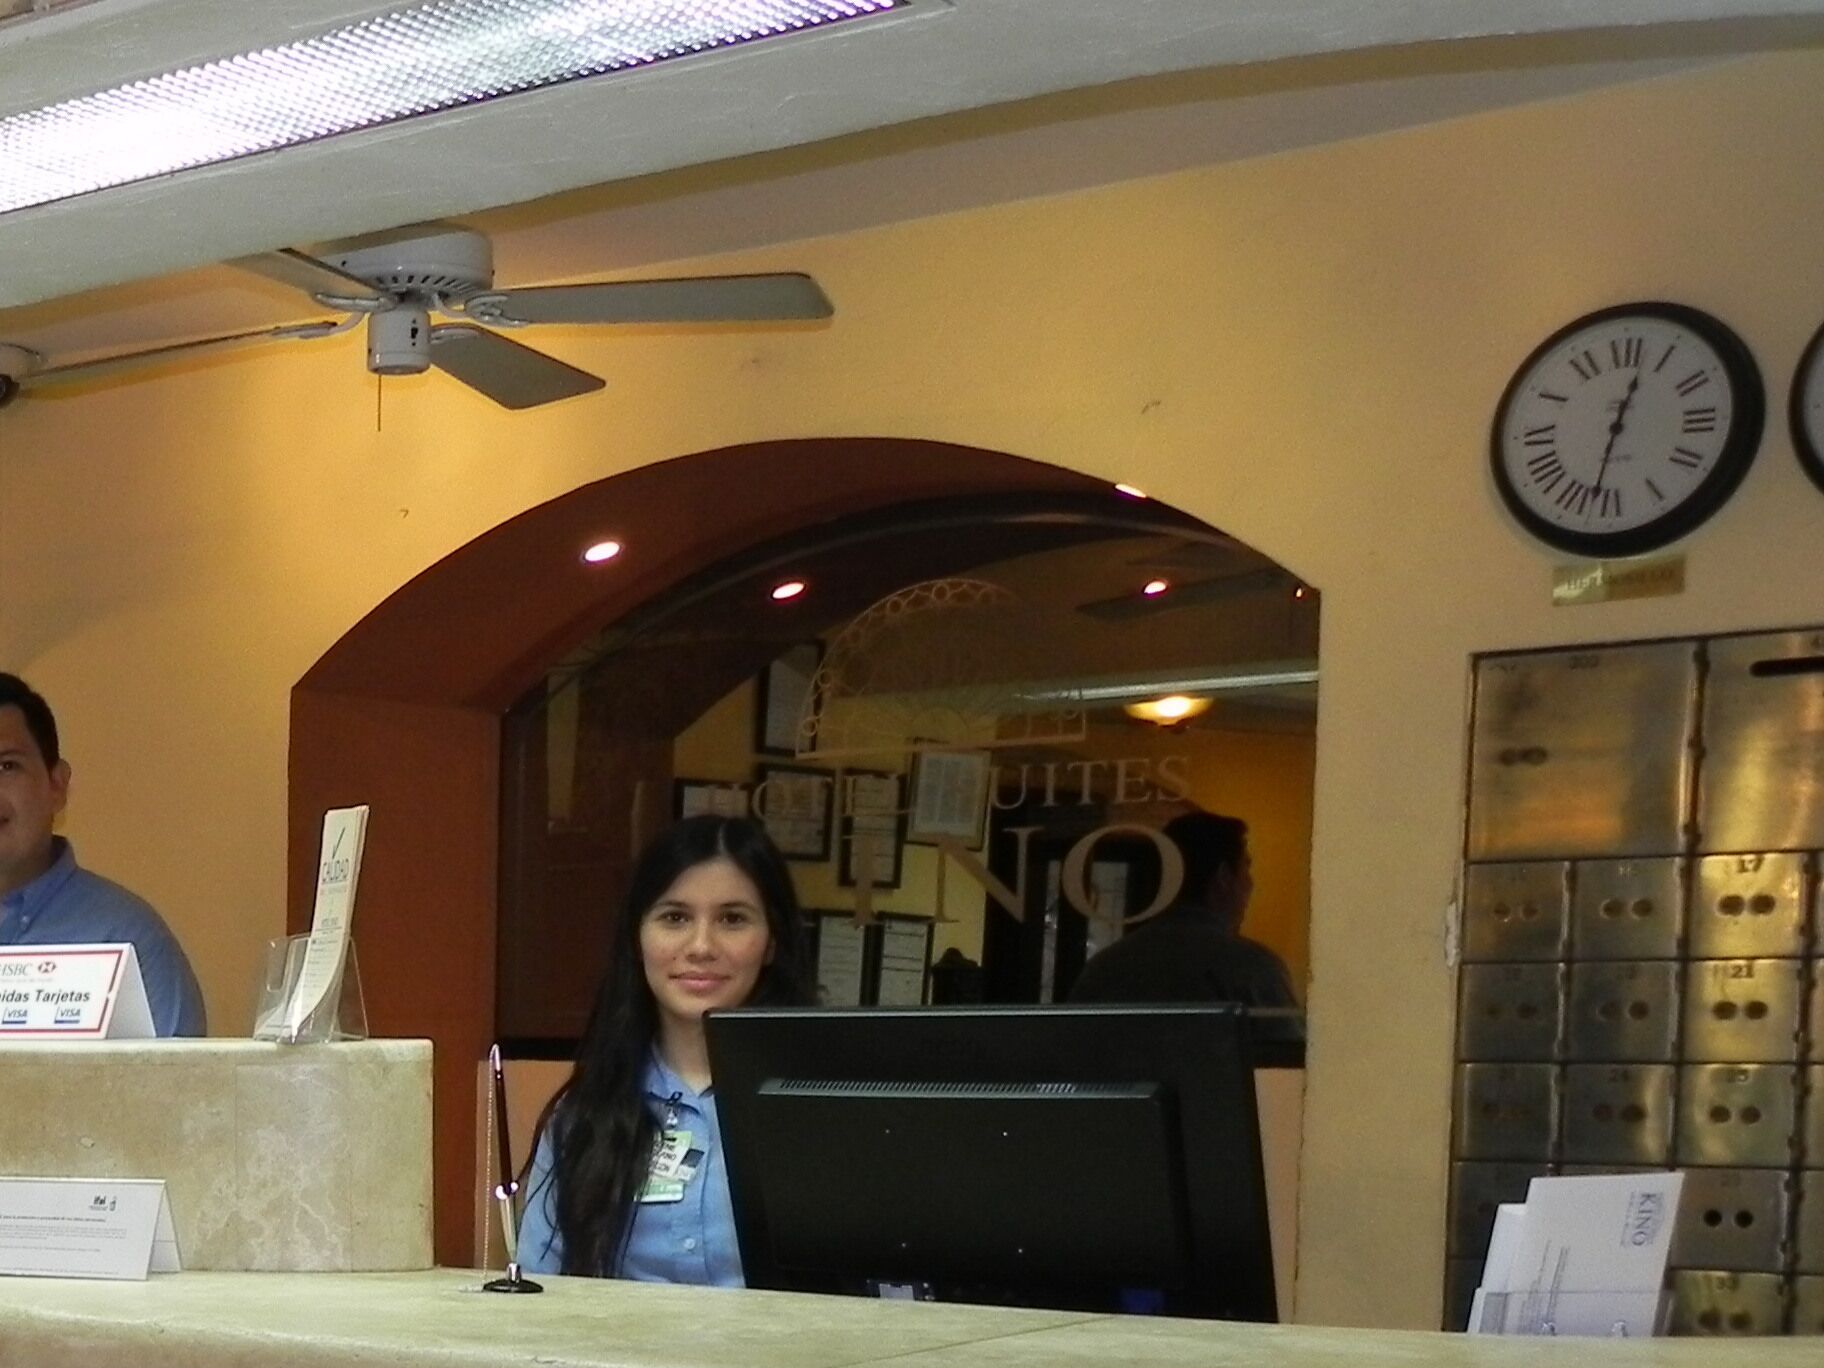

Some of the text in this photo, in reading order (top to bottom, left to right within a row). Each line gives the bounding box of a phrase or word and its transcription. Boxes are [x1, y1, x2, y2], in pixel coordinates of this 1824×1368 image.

[1737, 857, 1766, 874] 17
[1731, 964, 1756, 980] 21
[34, 988, 91, 1005] Tarjetas
[7, 1008, 81, 1018] VISA VISA
[1631, 1193, 1657, 1247] KINO
